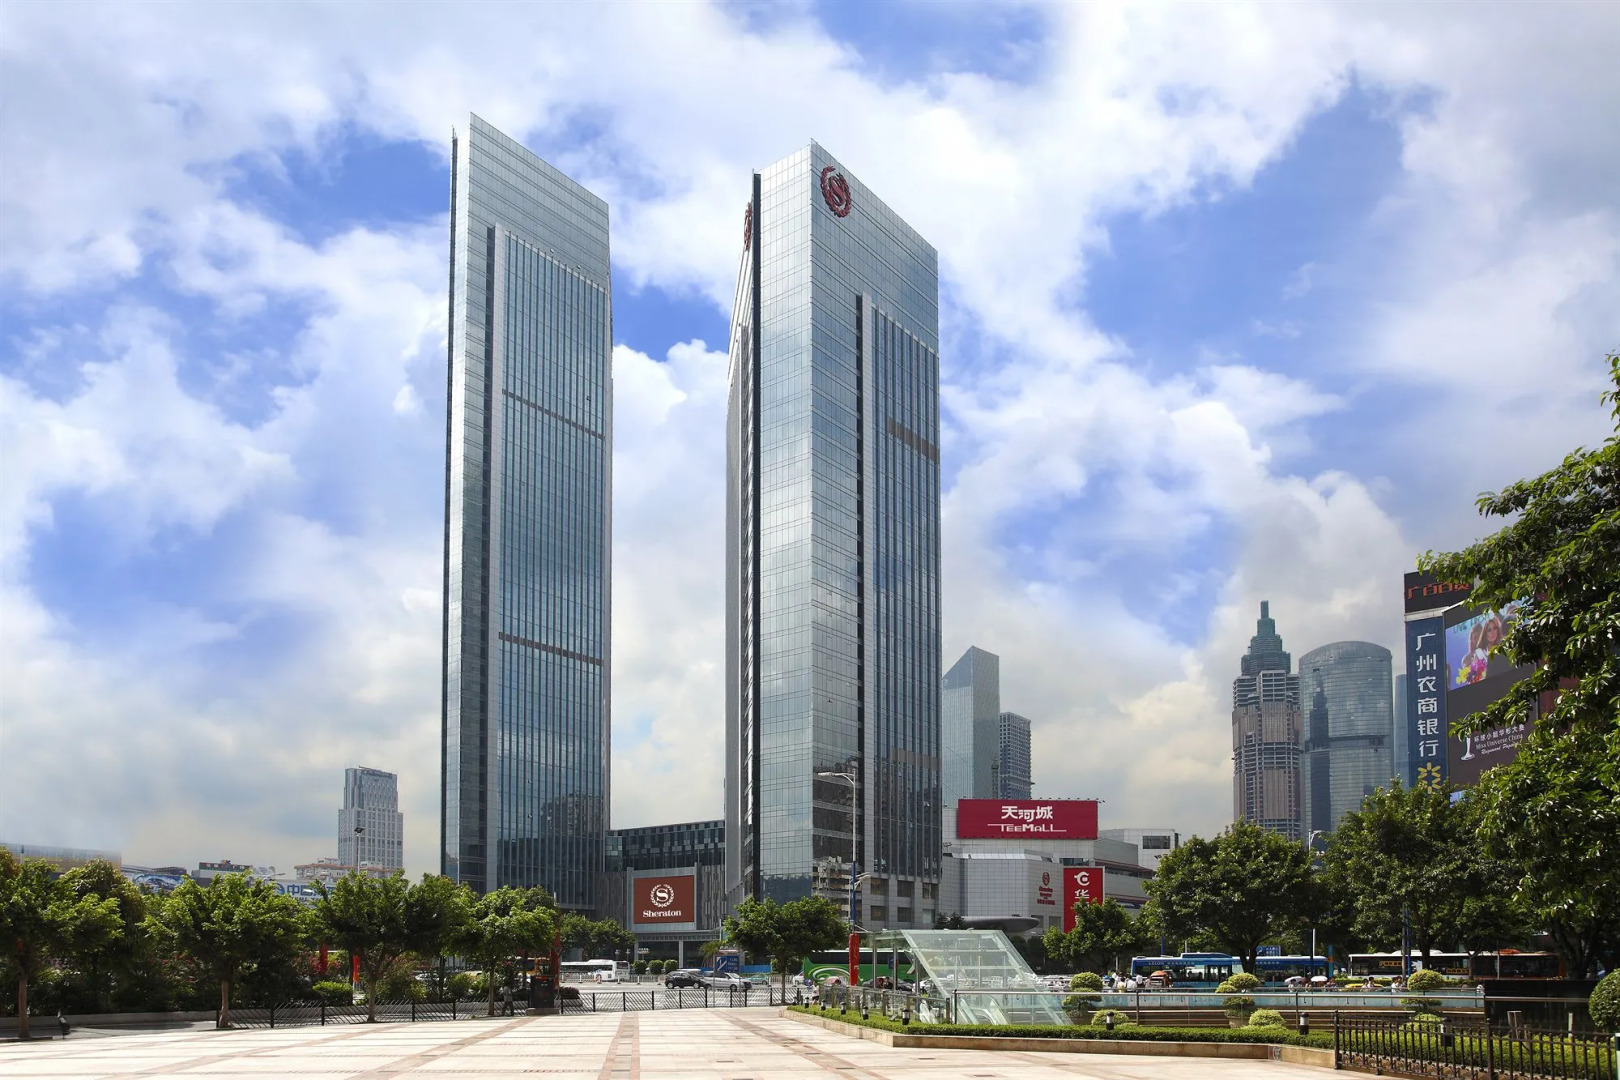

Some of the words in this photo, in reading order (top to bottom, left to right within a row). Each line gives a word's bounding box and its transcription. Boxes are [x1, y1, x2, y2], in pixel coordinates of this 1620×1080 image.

[1415, 632, 1439, 758] 广州农商银行
[1486, 737, 1508, 747] Universe
[1001, 805, 1053, 822] 天河城
[642, 909, 682, 918] Sheraton
